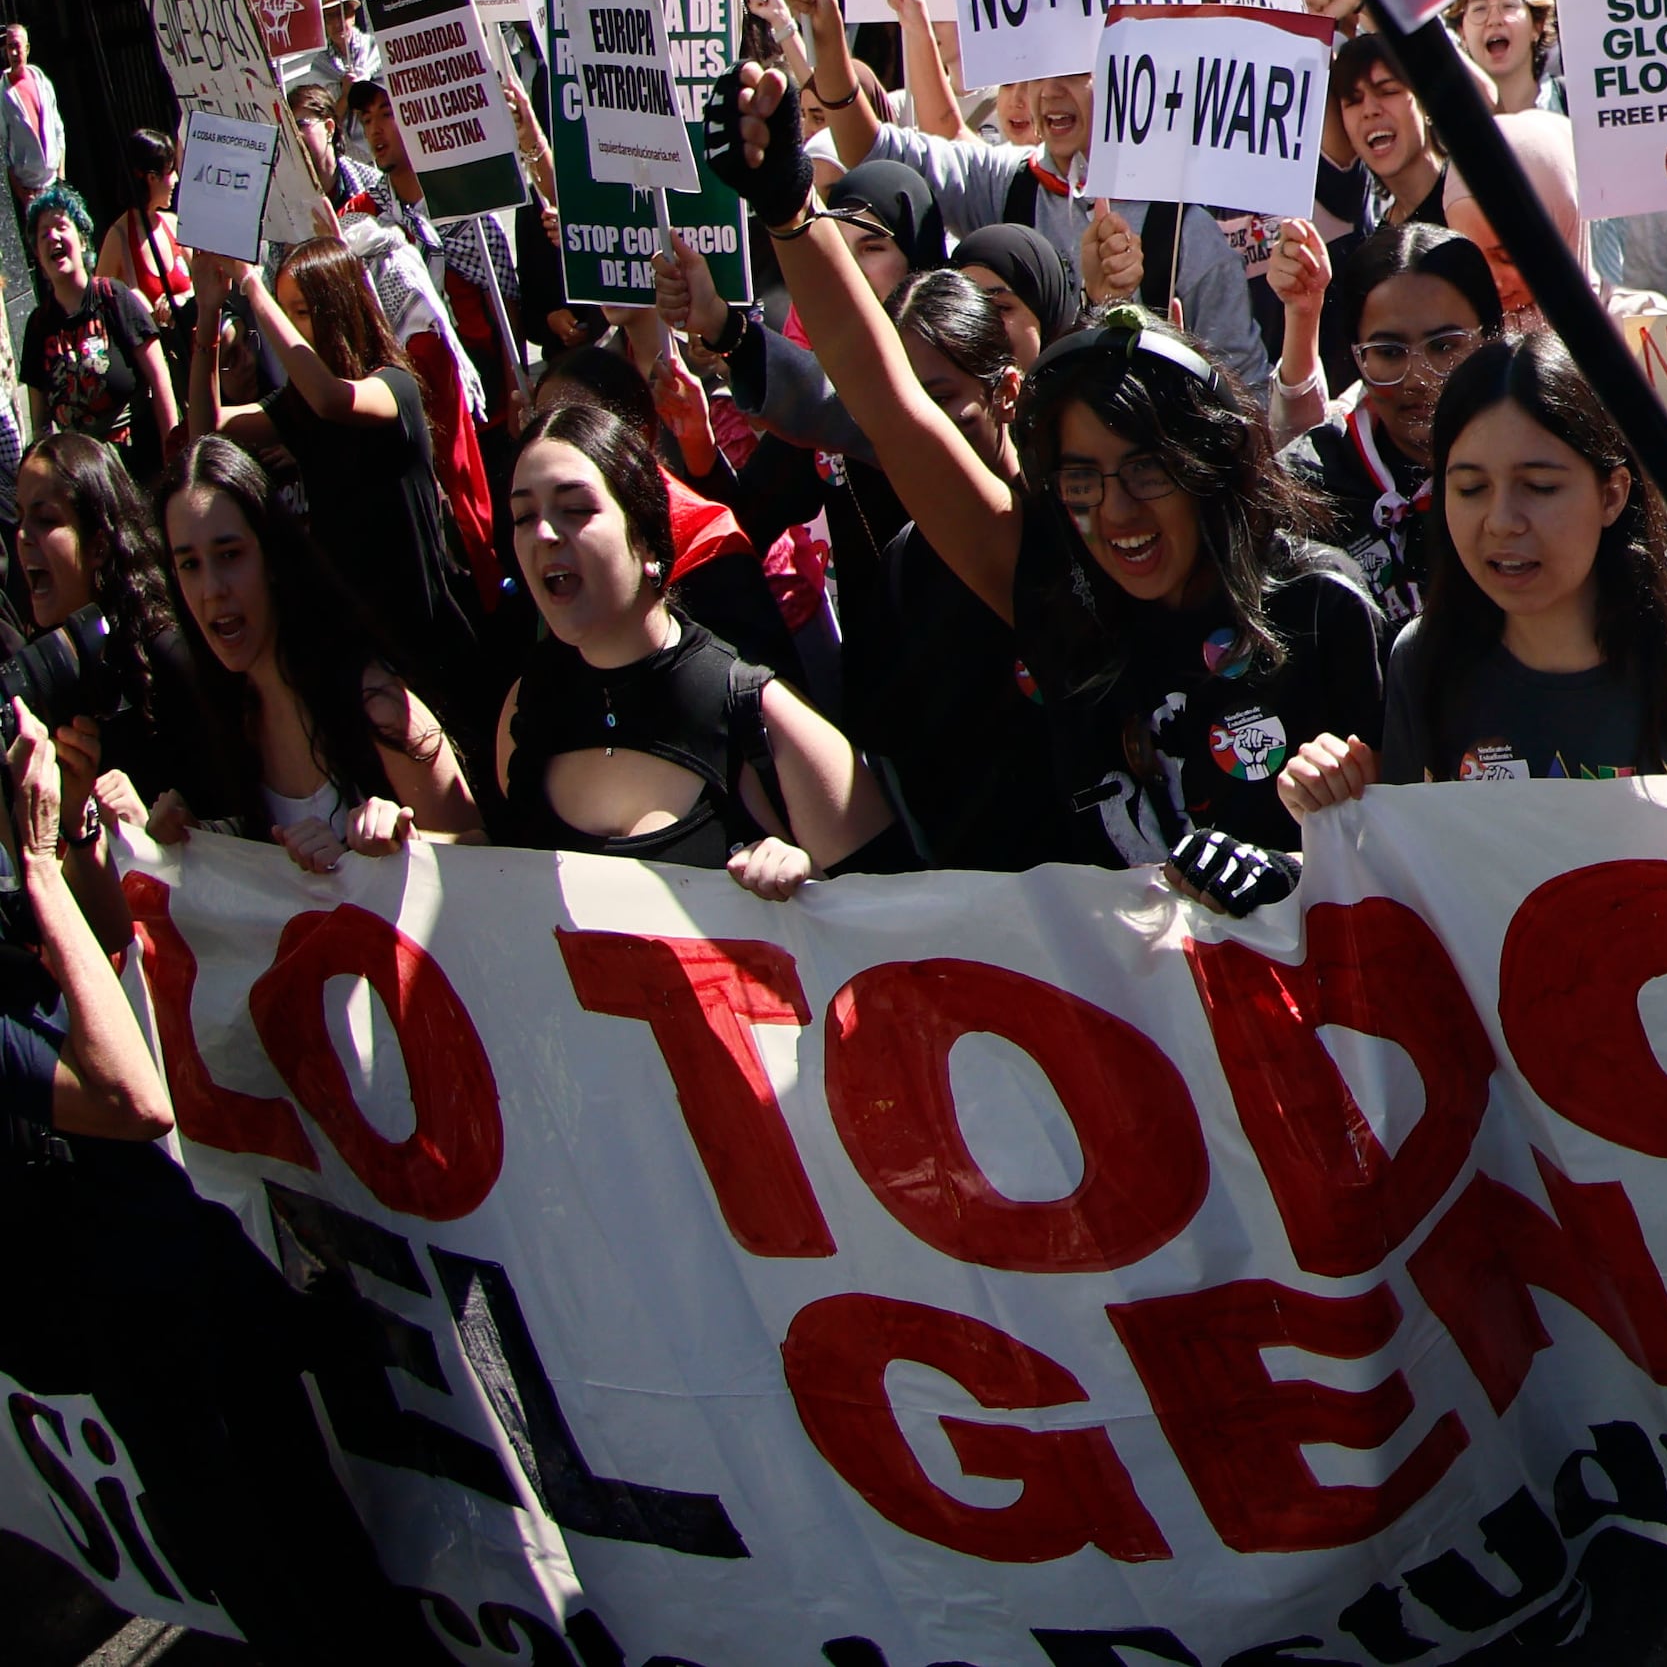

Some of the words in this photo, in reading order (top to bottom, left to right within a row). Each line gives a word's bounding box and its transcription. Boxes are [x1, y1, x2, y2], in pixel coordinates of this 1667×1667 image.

[386, 21, 468, 66] SOLIDARIDAD
[590, 6, 656, 58] EUROPA
[388, 50, 487, 97] INTERNACIONAL
[583, 64, 676, 118] PATROCINA
[399, 100, 425, 127] CON
[424, 96, 442, 120] LA
[440, 82, 489, 118] CAUSA
[1104, 53, 1157, 145] NO
[1164, 70, 1183, 131] +
[1192, 55, 1312, 162] WAR!
[1597, 105, 1654, 129] FREE
[418, 116, 487, 156] PALESTINA
[567, 224, 619, 255] STOP
[601, 260, 628, 289] DE
[121, 870, 505, 1222] LO
[266, 1178, 752, 1560] EL
